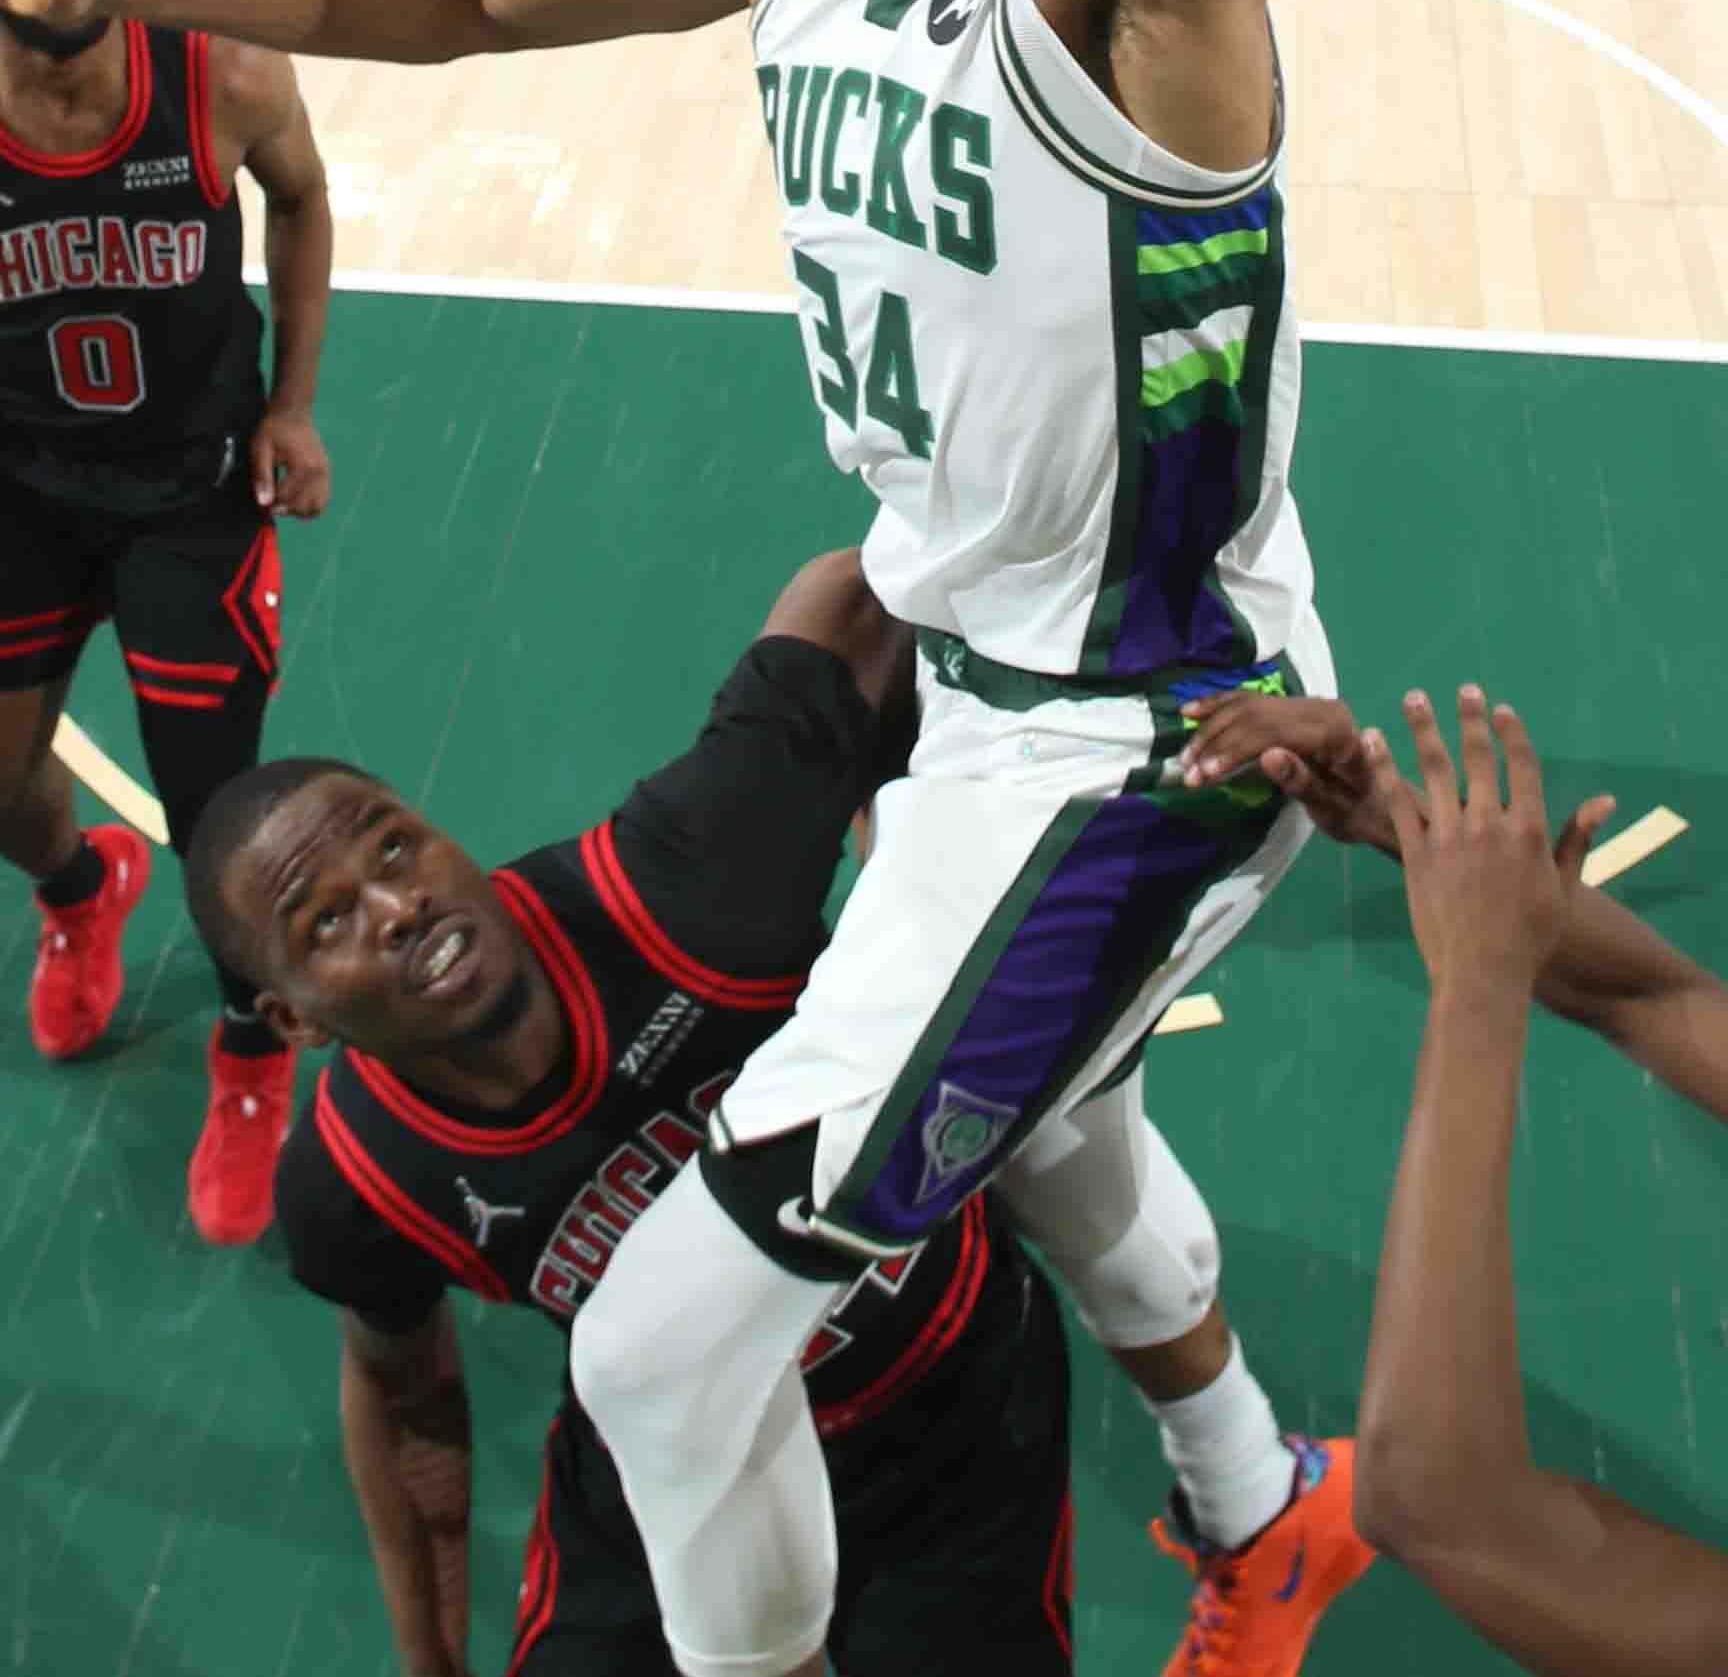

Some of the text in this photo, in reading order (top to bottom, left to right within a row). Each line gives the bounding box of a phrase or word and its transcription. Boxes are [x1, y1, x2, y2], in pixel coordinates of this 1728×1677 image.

[48, 313, 146, 414] 0
[791, 248, 936, 461] 34
[529, 1069, 735, 1316] CHICA
